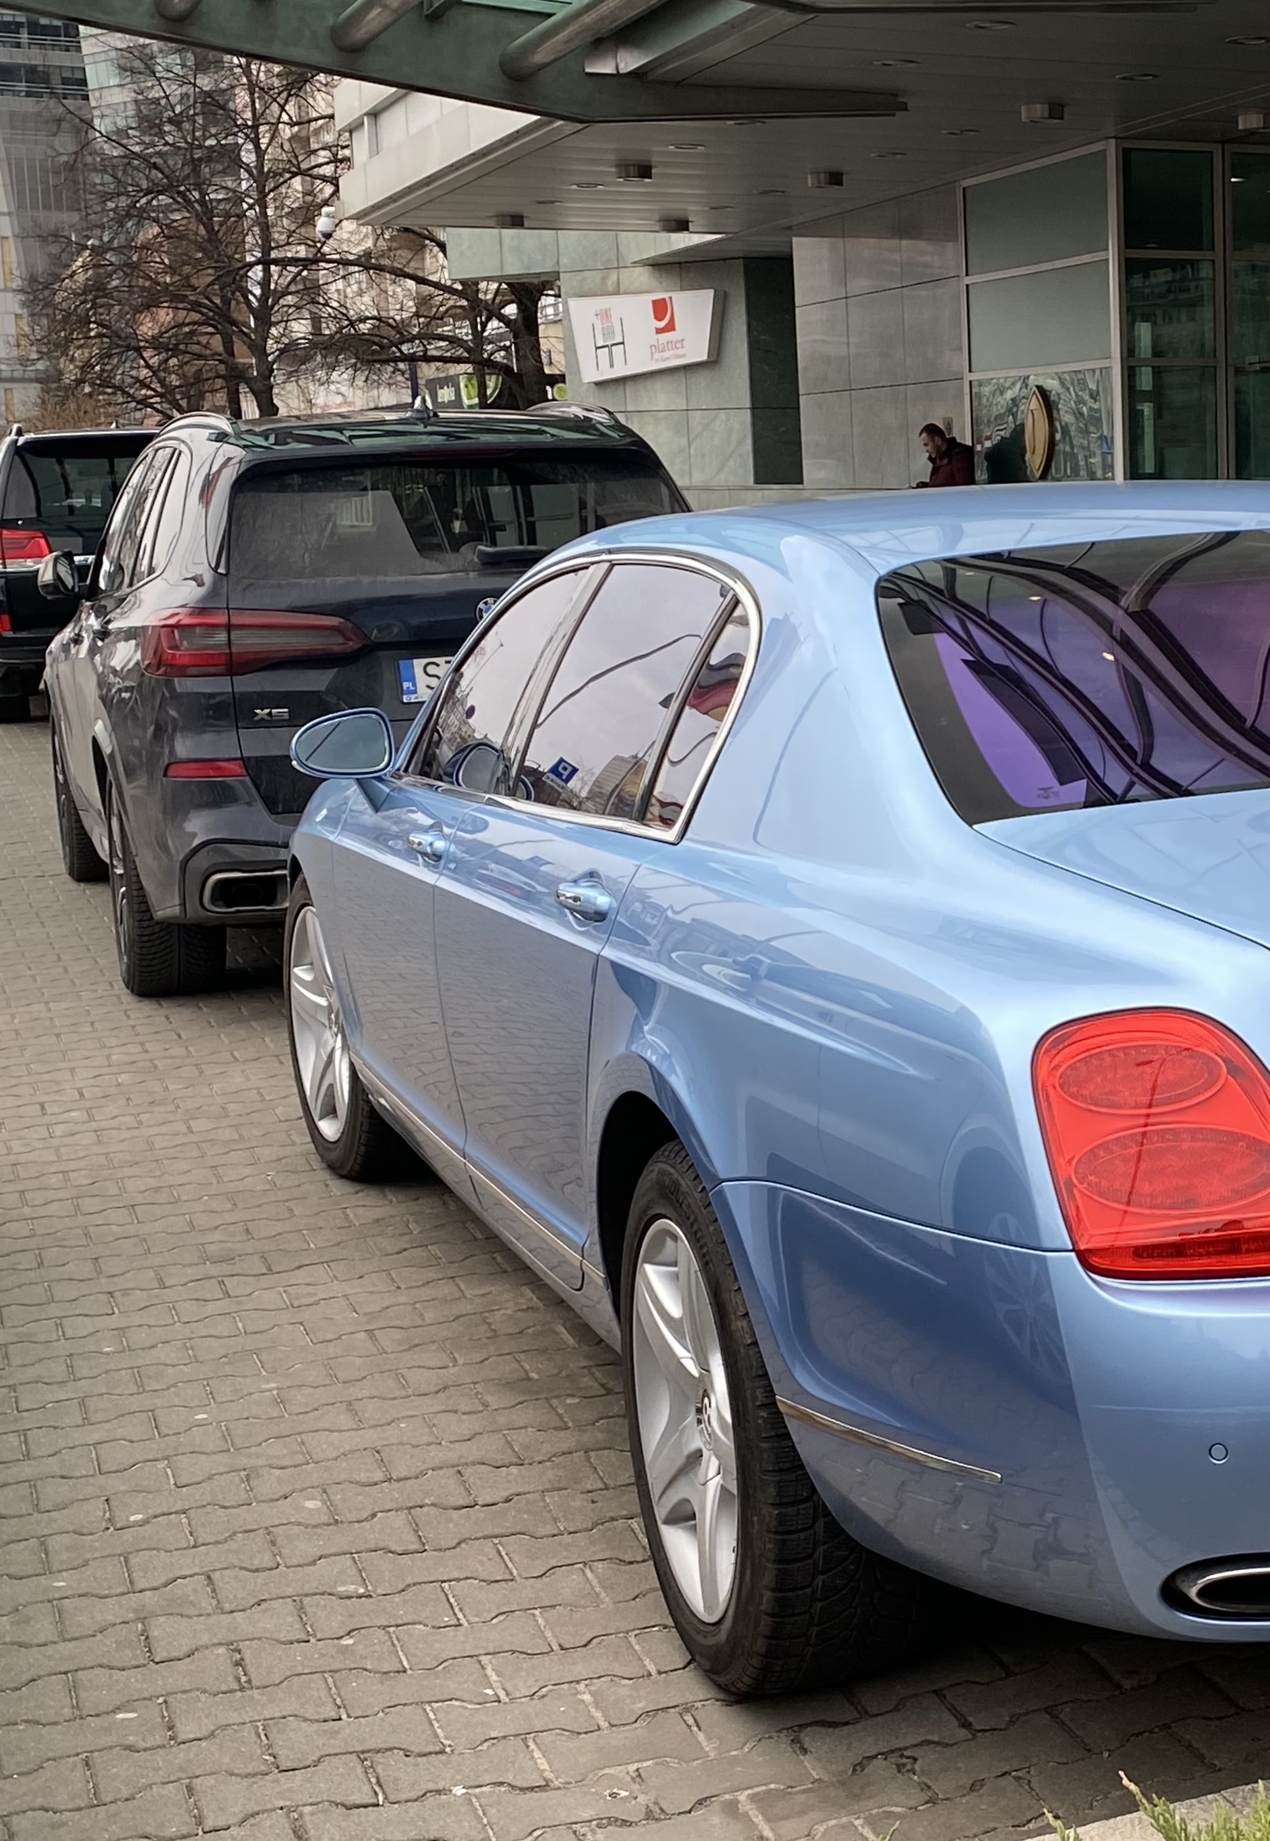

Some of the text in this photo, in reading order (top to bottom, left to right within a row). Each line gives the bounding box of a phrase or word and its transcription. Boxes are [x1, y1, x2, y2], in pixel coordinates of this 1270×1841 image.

[650, 337, 686, 361] platter
[403, 682, 415, 690] PL
[253, 708, 289, 720] X5
